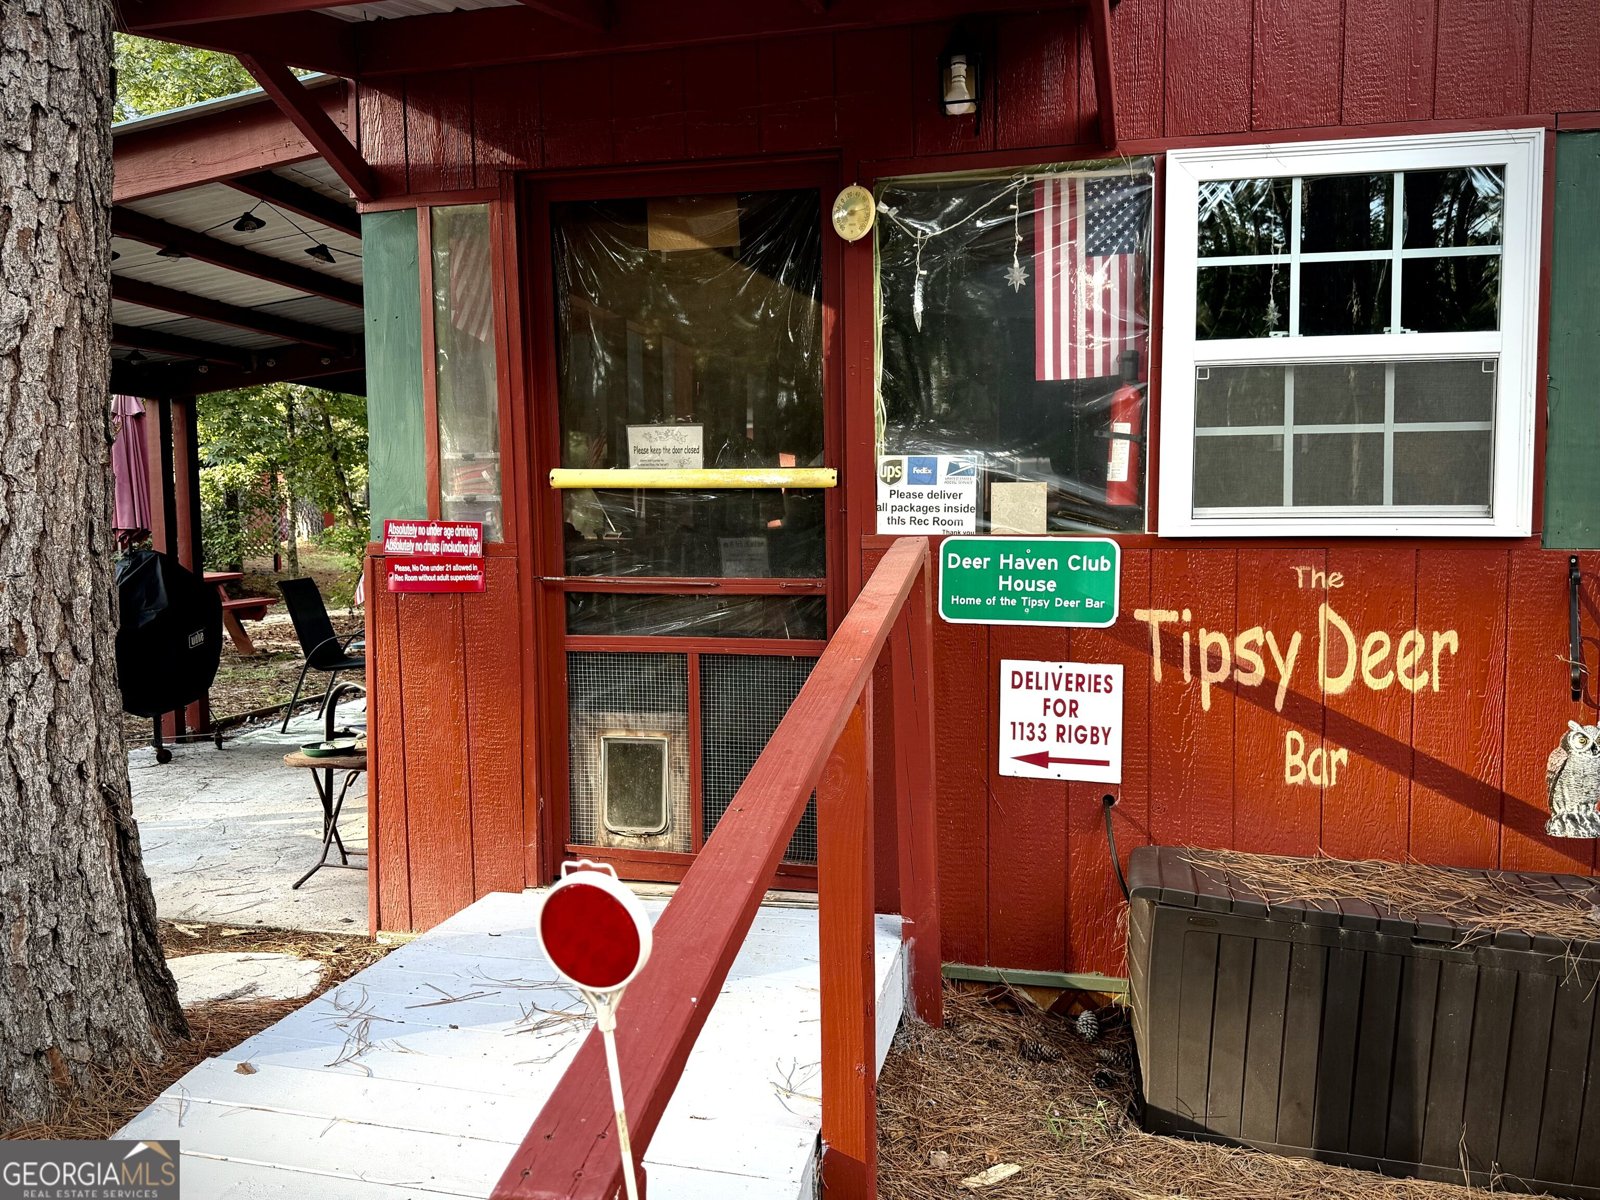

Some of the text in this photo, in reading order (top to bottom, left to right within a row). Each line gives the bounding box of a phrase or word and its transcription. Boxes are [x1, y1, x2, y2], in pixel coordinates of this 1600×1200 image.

[634, 445, 700, 456] Please keep the door closed
[880, 465, 902, 482] ups
[889, 489, 963, 500] Please deliver
[877, 502, 976, 514] all packages inside
[887, 516, 963, 526] this Rec Room
[388, 522, 478, 540] Absolutely no under age drinking
[385, 538, 480, 556] Absolutely no drugs (including pot)
[395, 564, 411, 572] Please,
[947, 553, 1111, 571] Deer Haven Club
[450, 574, 479, 582] supervision
[998, 575, 1056, 591] House
[1289, 565, 1344, 589] The
[951, 595, 1105, 608] Home of the Tipsy Deer Bar
[1133, 601, 1458, 712] Tipsy Deer
[1011, 670, 1113, 694] DELIVERIES
[1043, 698, 1079, 718] FOR
[1010, 722, 1112, 745] 1133 RIGBY
[1284, 730, 1348, 788] Bar
